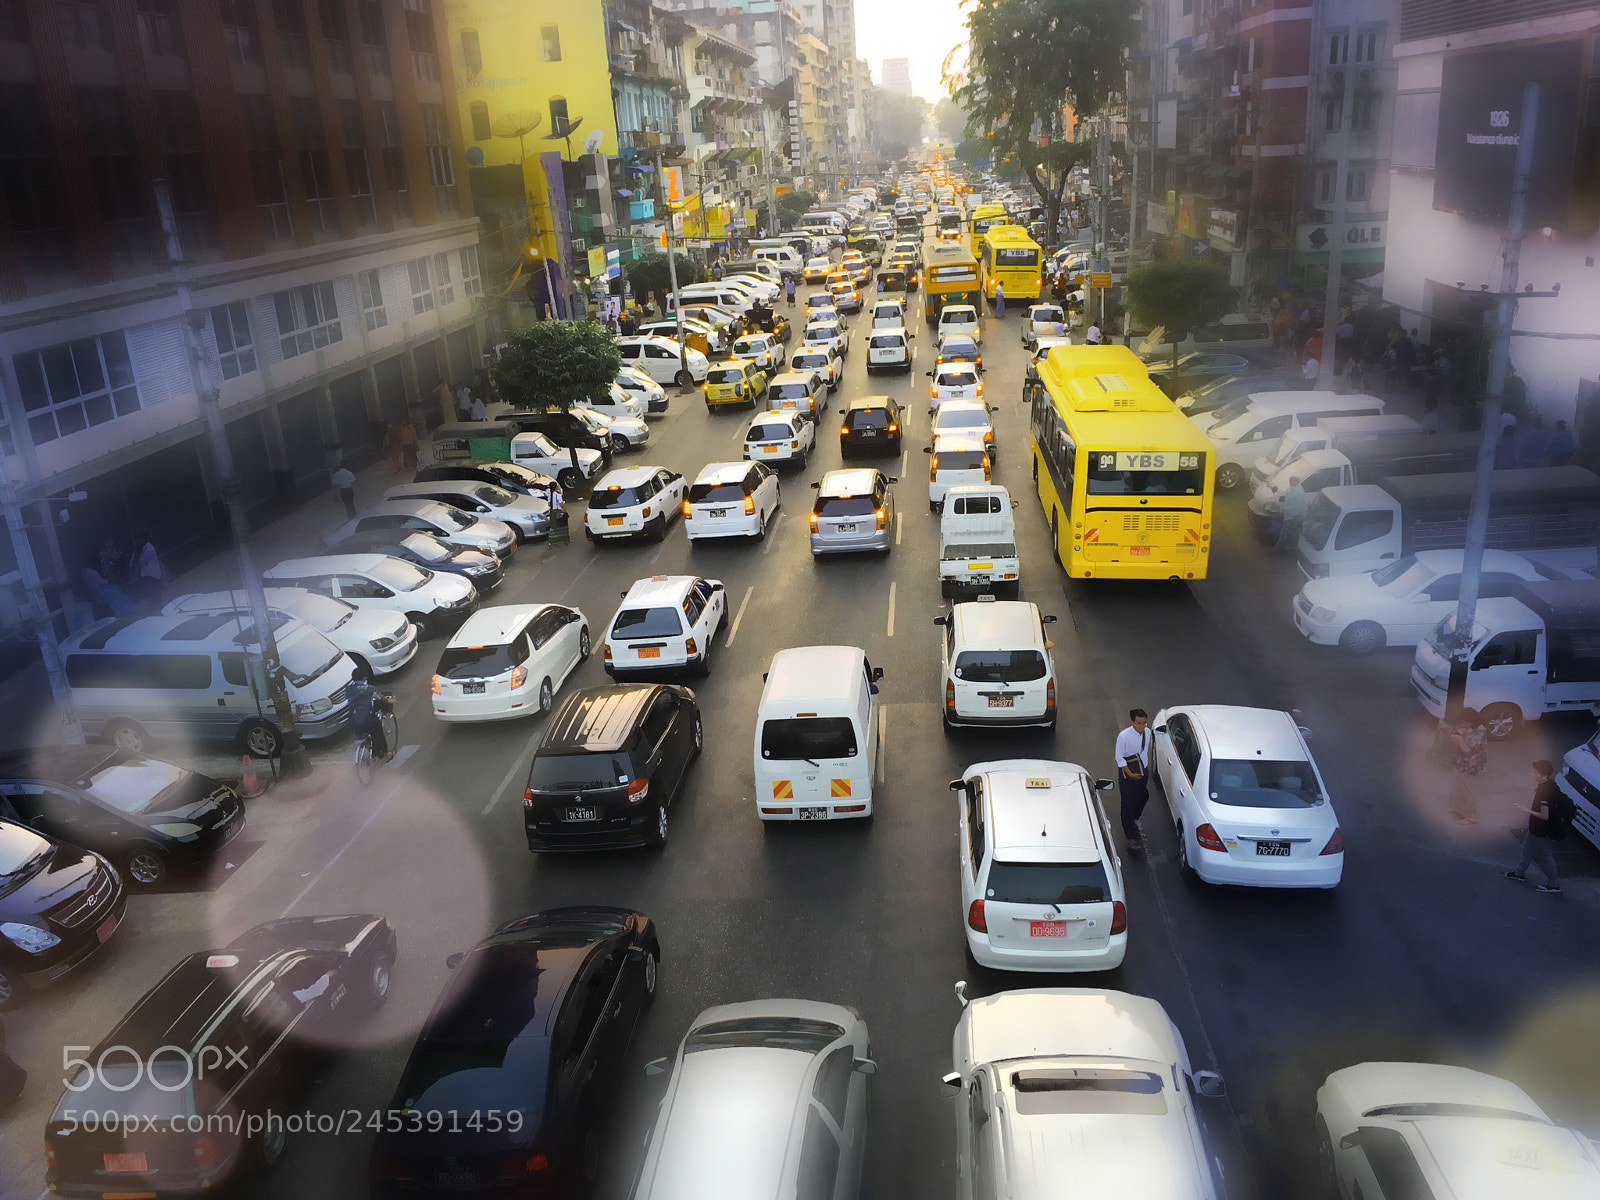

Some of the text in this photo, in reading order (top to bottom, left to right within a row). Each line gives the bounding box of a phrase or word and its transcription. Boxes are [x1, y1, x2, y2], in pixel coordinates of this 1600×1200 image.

[1126, 455, 1165, 468] YBS
[1179, 456, 1198, 467] 58
[568, 810, 594, 819] 1K-4181
[1257, 846, 1289, 856] 7G-7770
